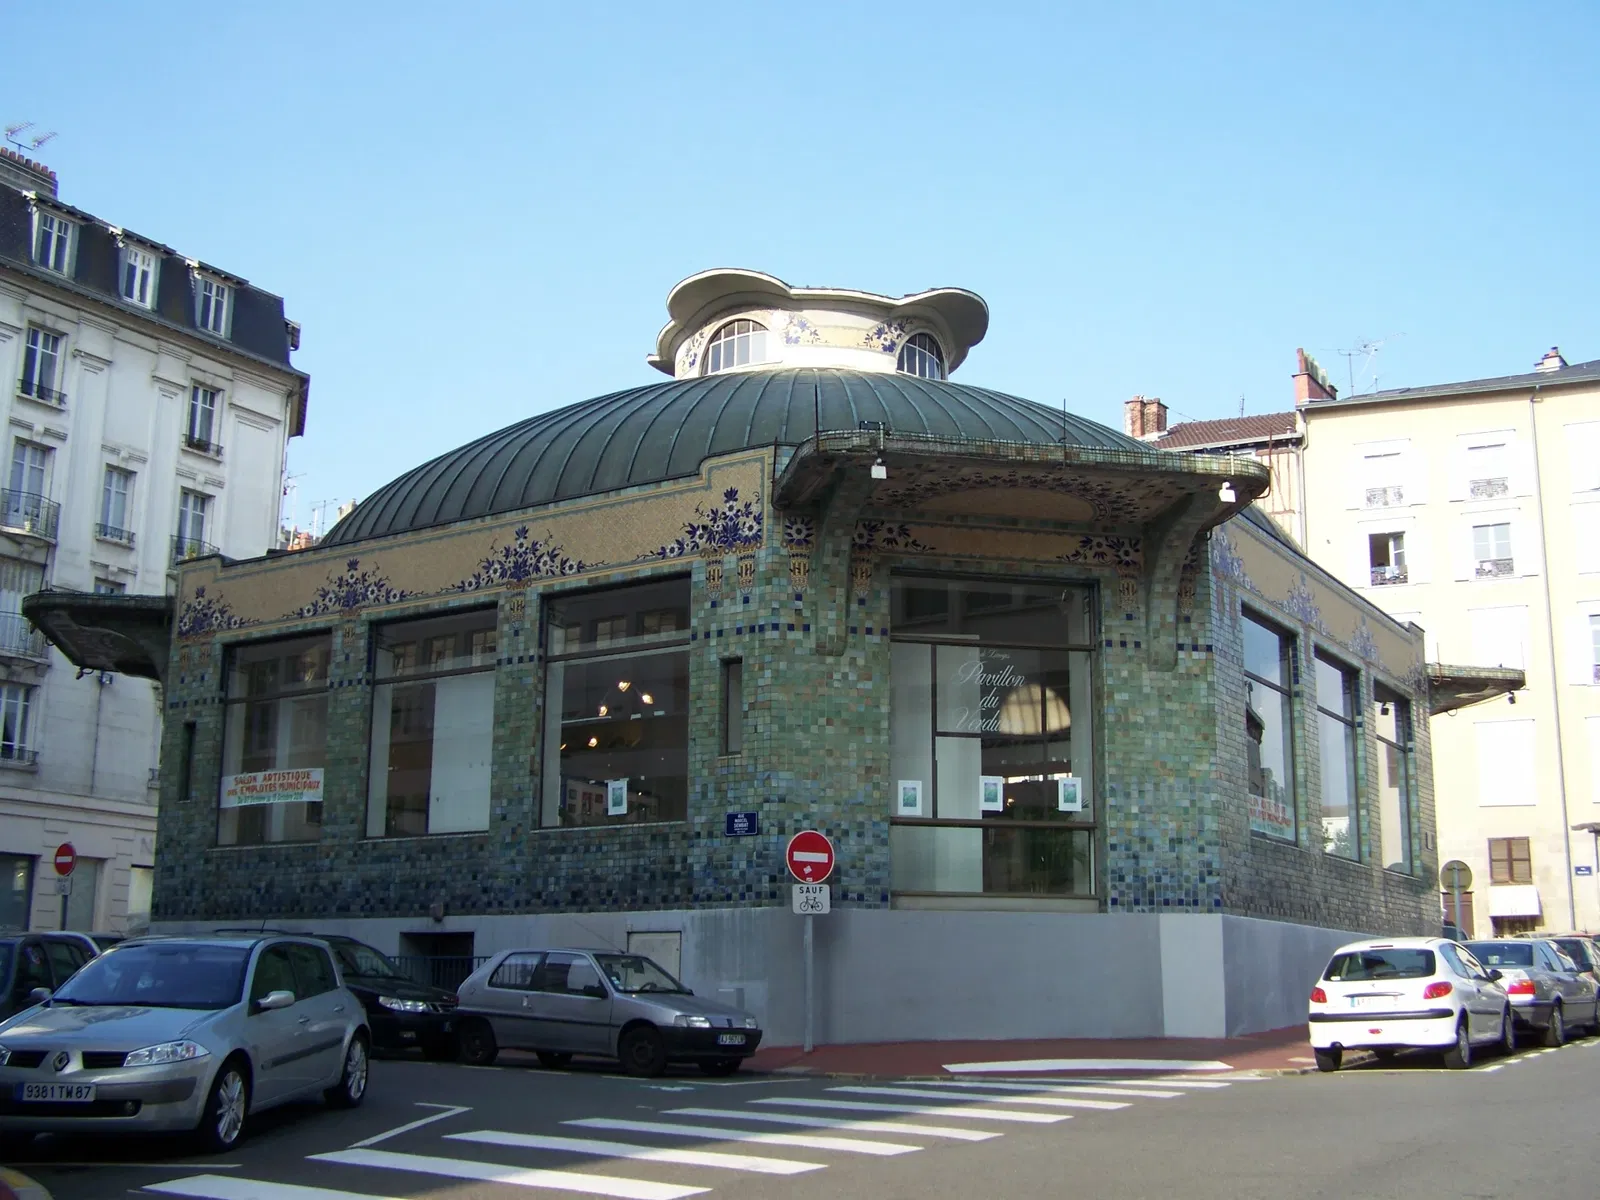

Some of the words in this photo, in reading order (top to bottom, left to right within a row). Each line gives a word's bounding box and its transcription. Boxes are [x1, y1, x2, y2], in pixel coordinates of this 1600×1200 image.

[957, 660, 1025, 687] Pavillon
[979, 687, 1000, 708] du
[234, 775, 257, 786] SALON
[263, 770, 311, 781] ARTISTIQUE
[278, 780, 320, 791] MUNICIPAUX
[799, 886, 824, 894] SAUF
[26, 1085, 55, 1099] 9381
[58, 1085, 74, 1099] TW
[75, 1086, 92, 1099] 87
